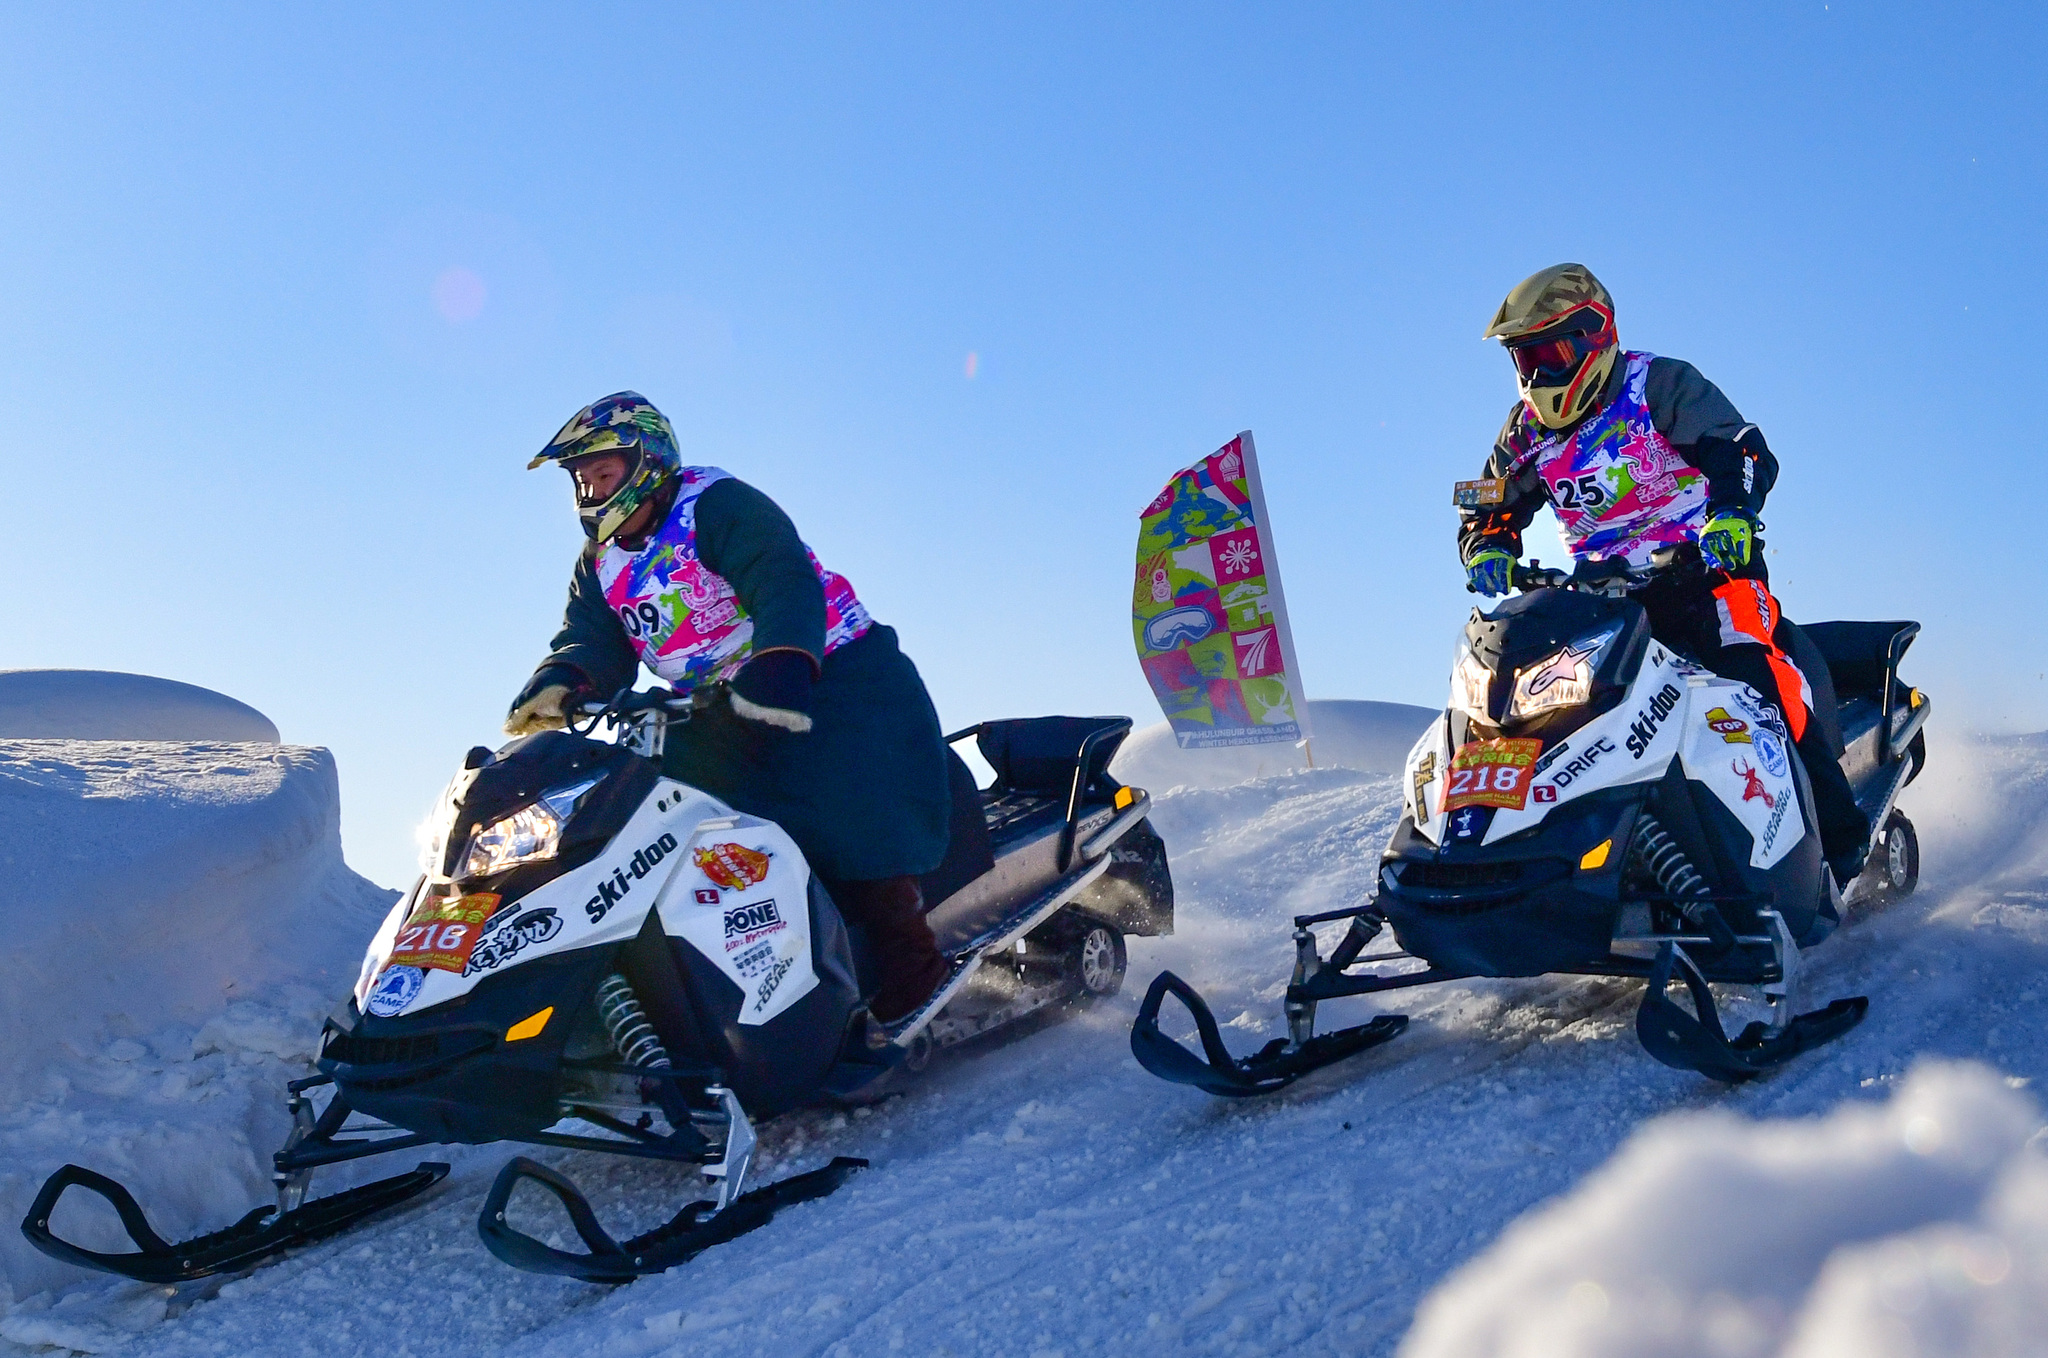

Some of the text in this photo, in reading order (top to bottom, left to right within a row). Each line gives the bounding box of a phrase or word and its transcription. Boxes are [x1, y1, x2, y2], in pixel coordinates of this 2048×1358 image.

[1472, 480, 1497, 488] DRIVER
[1200, 727, 1245, 739] HULUNBUIR
[1625, 683, 1681, 760] ski-doo
[1712, 720, 1744, 731] TOP
[1448, 765, 1520, 796] 218
[1761, 787, 1792, 858] TOURING
[584, 832, 679, 925] ski-doo
